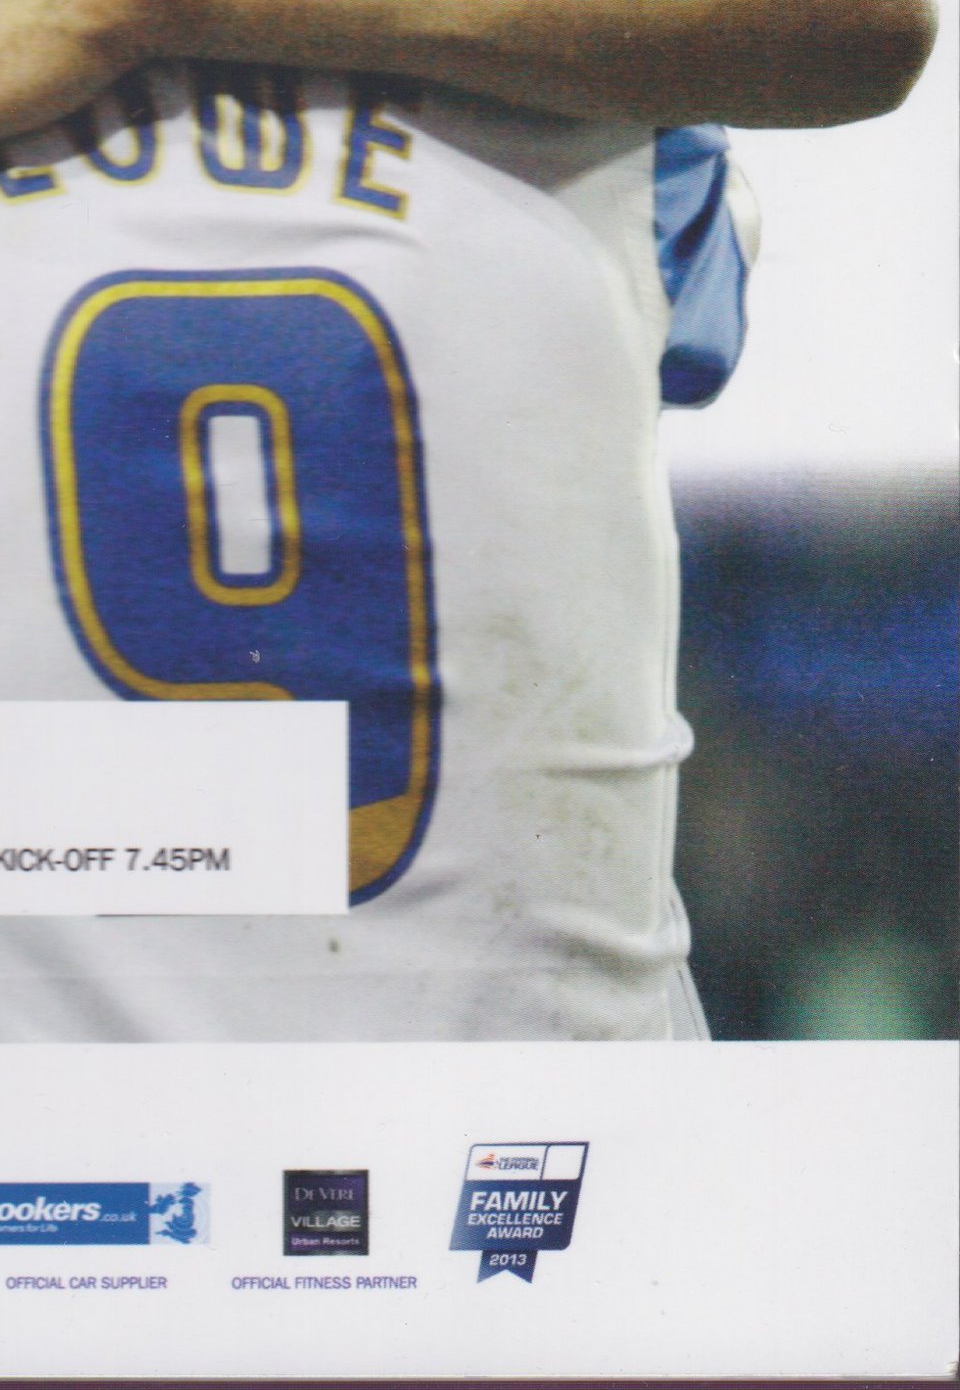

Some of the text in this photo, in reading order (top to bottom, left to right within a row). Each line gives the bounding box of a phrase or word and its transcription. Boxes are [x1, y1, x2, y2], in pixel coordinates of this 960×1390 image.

[37, 267, 442, 907] 9
[125, 848, 230, 872] 7.45PM
[470, 1191, 568, 1211] FAMILY
[290, 1215, 361, 1228] VILLAGE
[467, 1213, 564, 1226] EXCELLENCE
[486, 1227, 544, 1239] AWARD
[322, 1236, 360, 1246] Resorts
[489, 1254, 528, 1266] 2013
[5, 1276, 168, 1290] OFFICIAL CAR SUPPLIER
[231, 1276, 417, 1290] OFFICIAL FITNESS PARTNER
